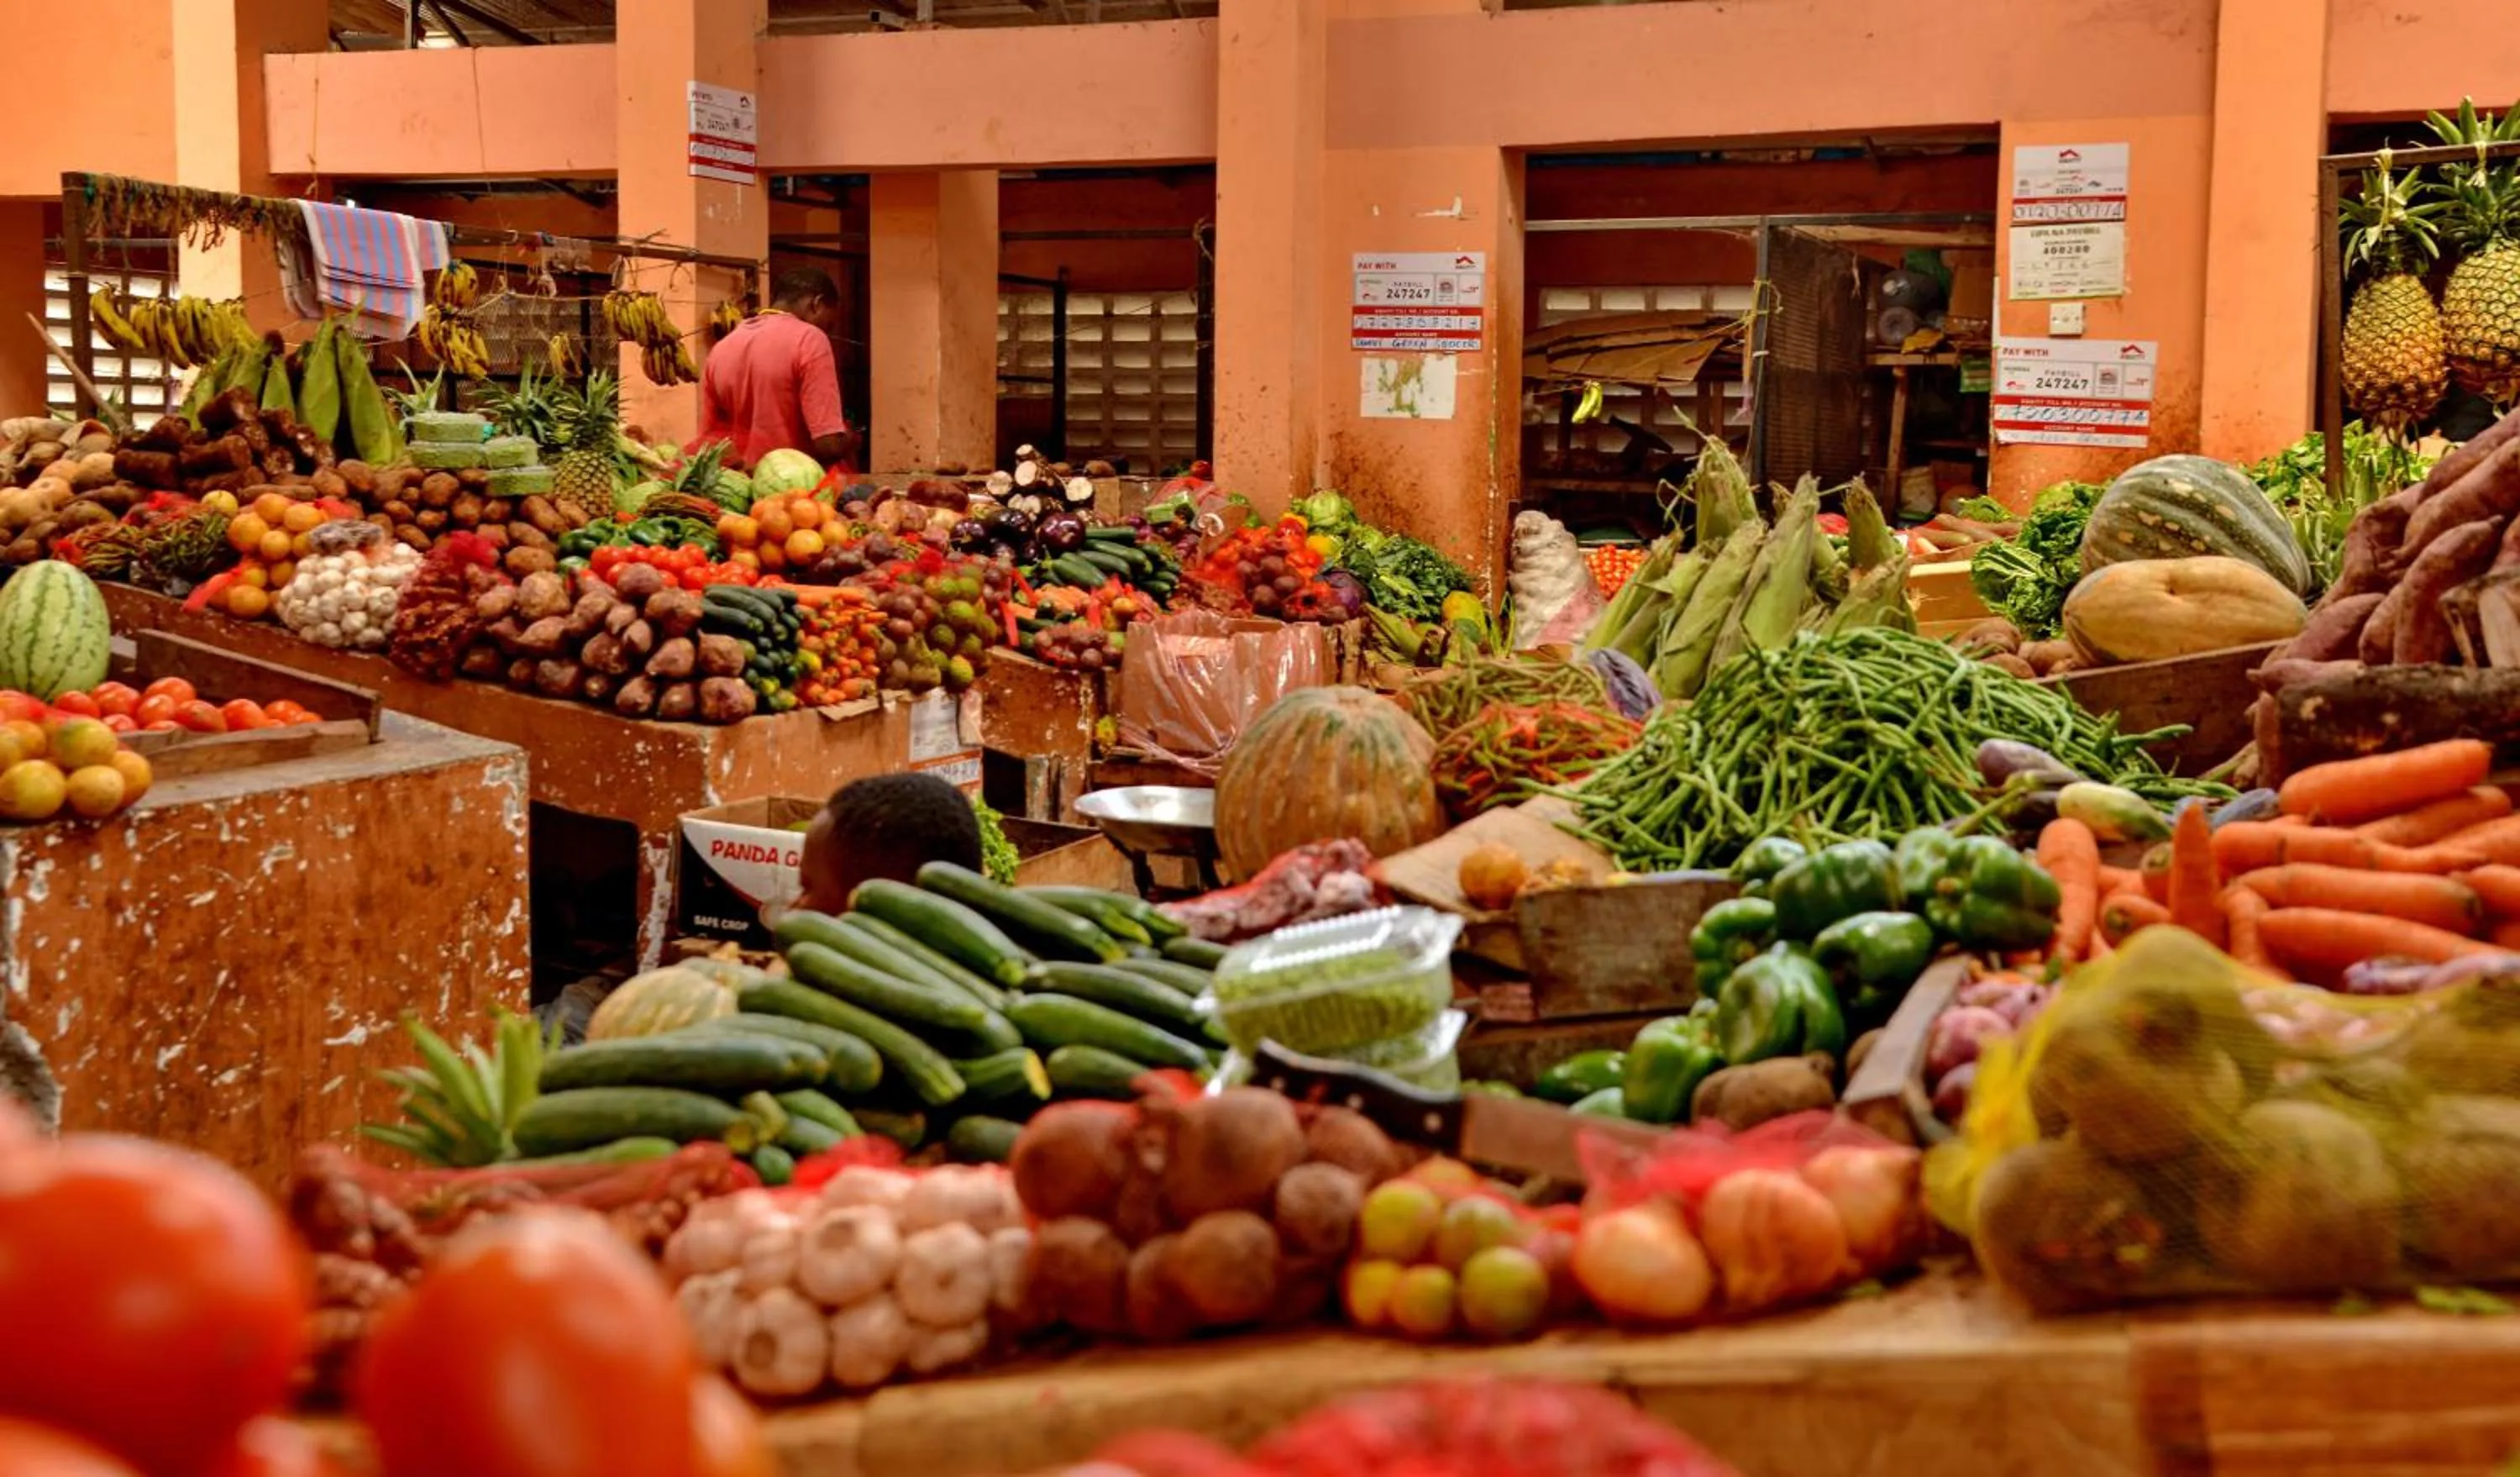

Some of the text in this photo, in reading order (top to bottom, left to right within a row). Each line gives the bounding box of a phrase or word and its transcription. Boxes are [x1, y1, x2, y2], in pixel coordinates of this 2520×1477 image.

[1357, 261, 1373, 270] PAY
[1386, 288, 1431, 299] 247247
[2035, 377, 2089, 390] 247247
[711, 839, 802, 867] PANDA G
[693, 914, 749, 931] SAFE CROP
